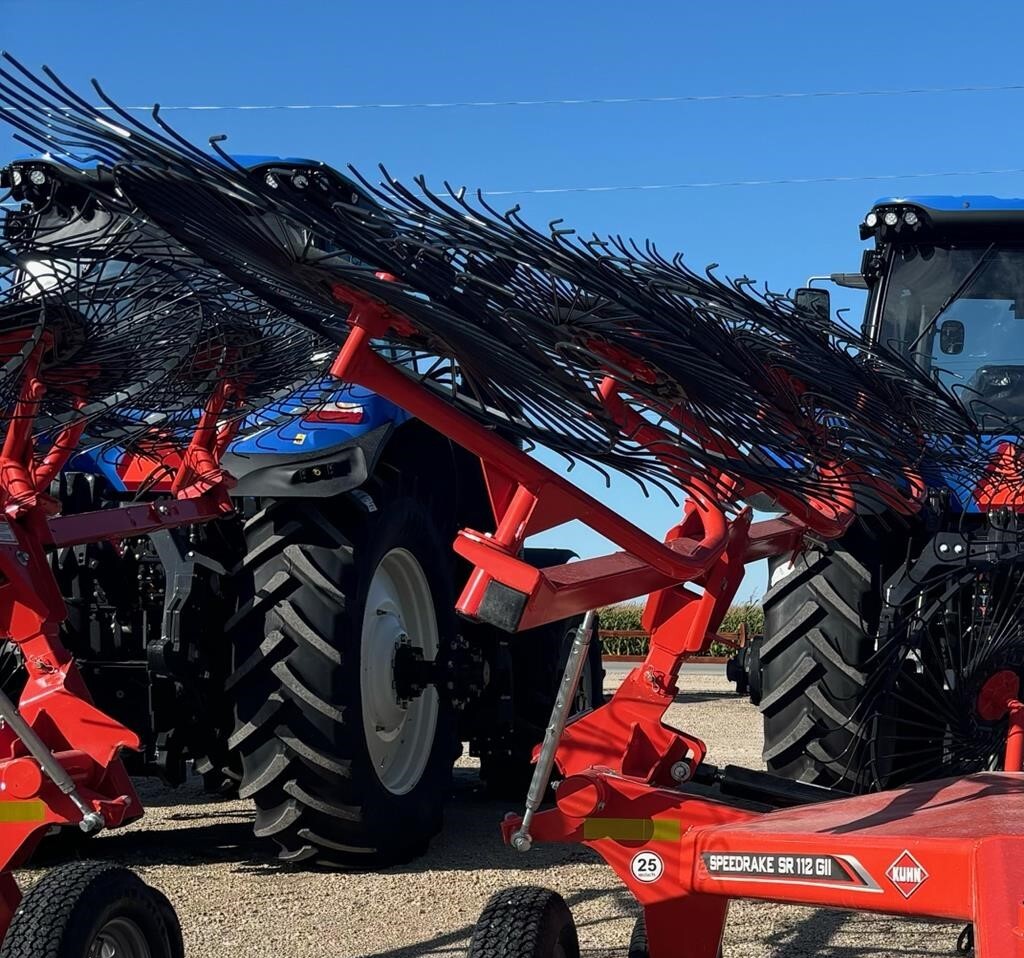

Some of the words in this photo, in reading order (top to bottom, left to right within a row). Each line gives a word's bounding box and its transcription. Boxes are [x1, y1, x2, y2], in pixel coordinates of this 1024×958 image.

[637, 858, 657, 872] 25
[709, 855, 775, 873] SPEEDRAKE
[778, 856, 795, 874] SR
[796, 857, 813, 875] 112
[892, 866, 921, 883] KUHN
